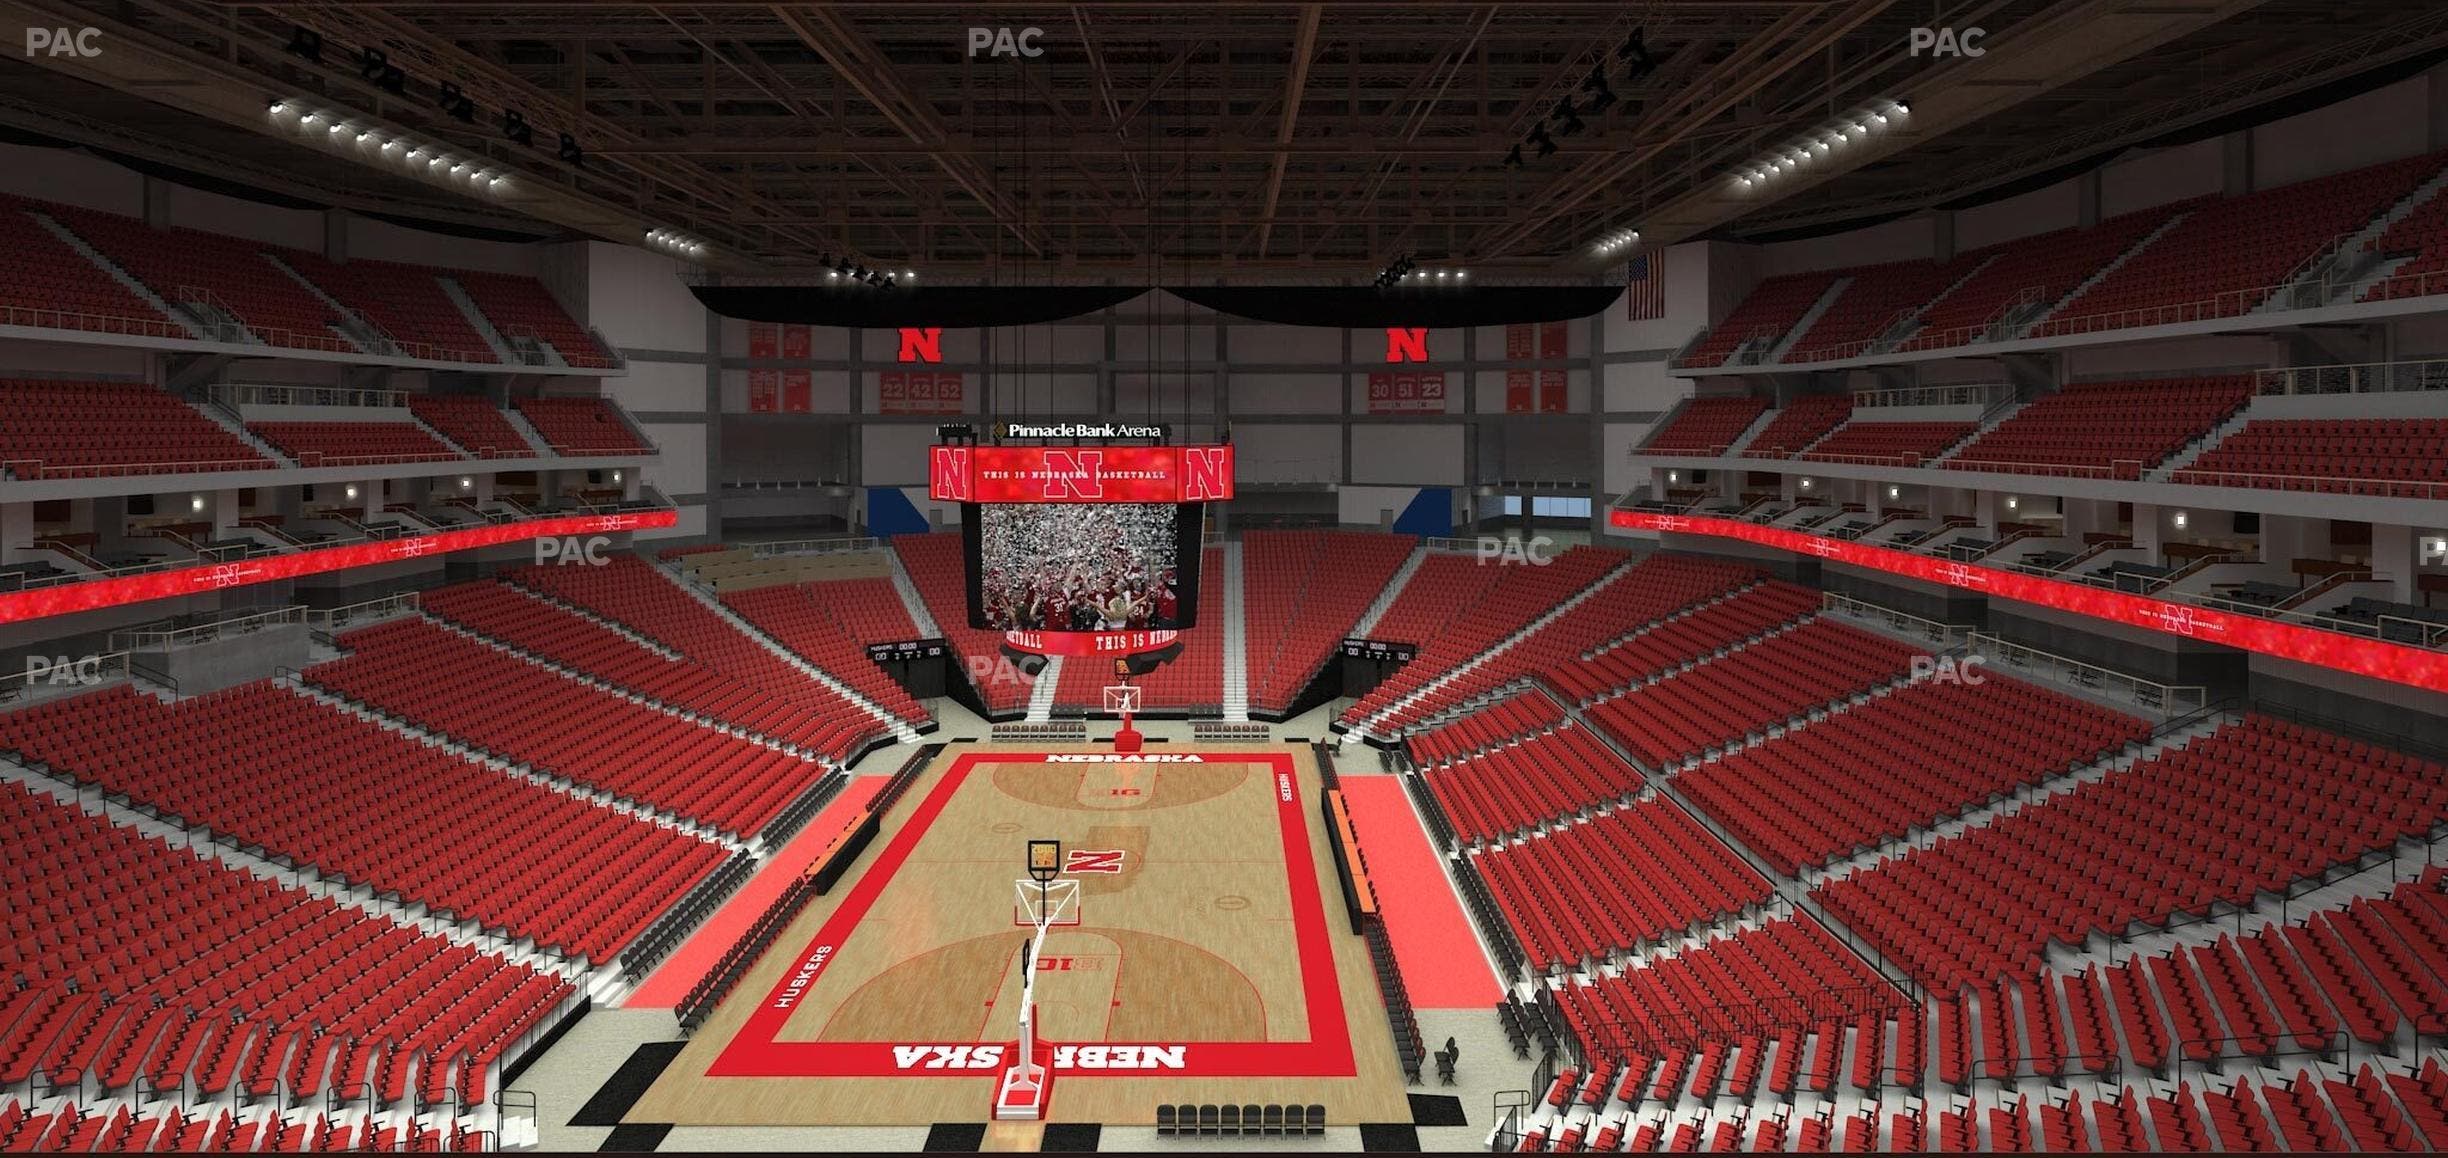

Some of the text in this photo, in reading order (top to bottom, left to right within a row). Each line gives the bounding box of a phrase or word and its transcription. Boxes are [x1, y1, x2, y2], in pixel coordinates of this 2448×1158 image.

[898, 327, 942, 363] N
[1386, 327, 1428, 363] N
[883, 384, 904, 398] 22
[911, 384, 932, 398] 42
[940, 384, 960, 398] 52
[1372, 384, 1389, 397] 30
[1422, 383, 1442, 397] 23
[1009, 423, 1161, 437] Pinnacle Bank Arena
[937, 449, 966, 500] N
[983, 470, 1009, 479] THIS
[1014, 470, 1026, 479] IS
[1044, 451, 1102, 498] N
[1186, 449, 1224, 500] N
[1095, 635, 1127, 650] THIS
[1133, 633, 1144, 648] IS
[1046, 754, 1204, 763] NEBRASKA
[773, 945, 833, 1008] HUSKERS
[892, 1046, 1187, 1069] NEBRSKA
